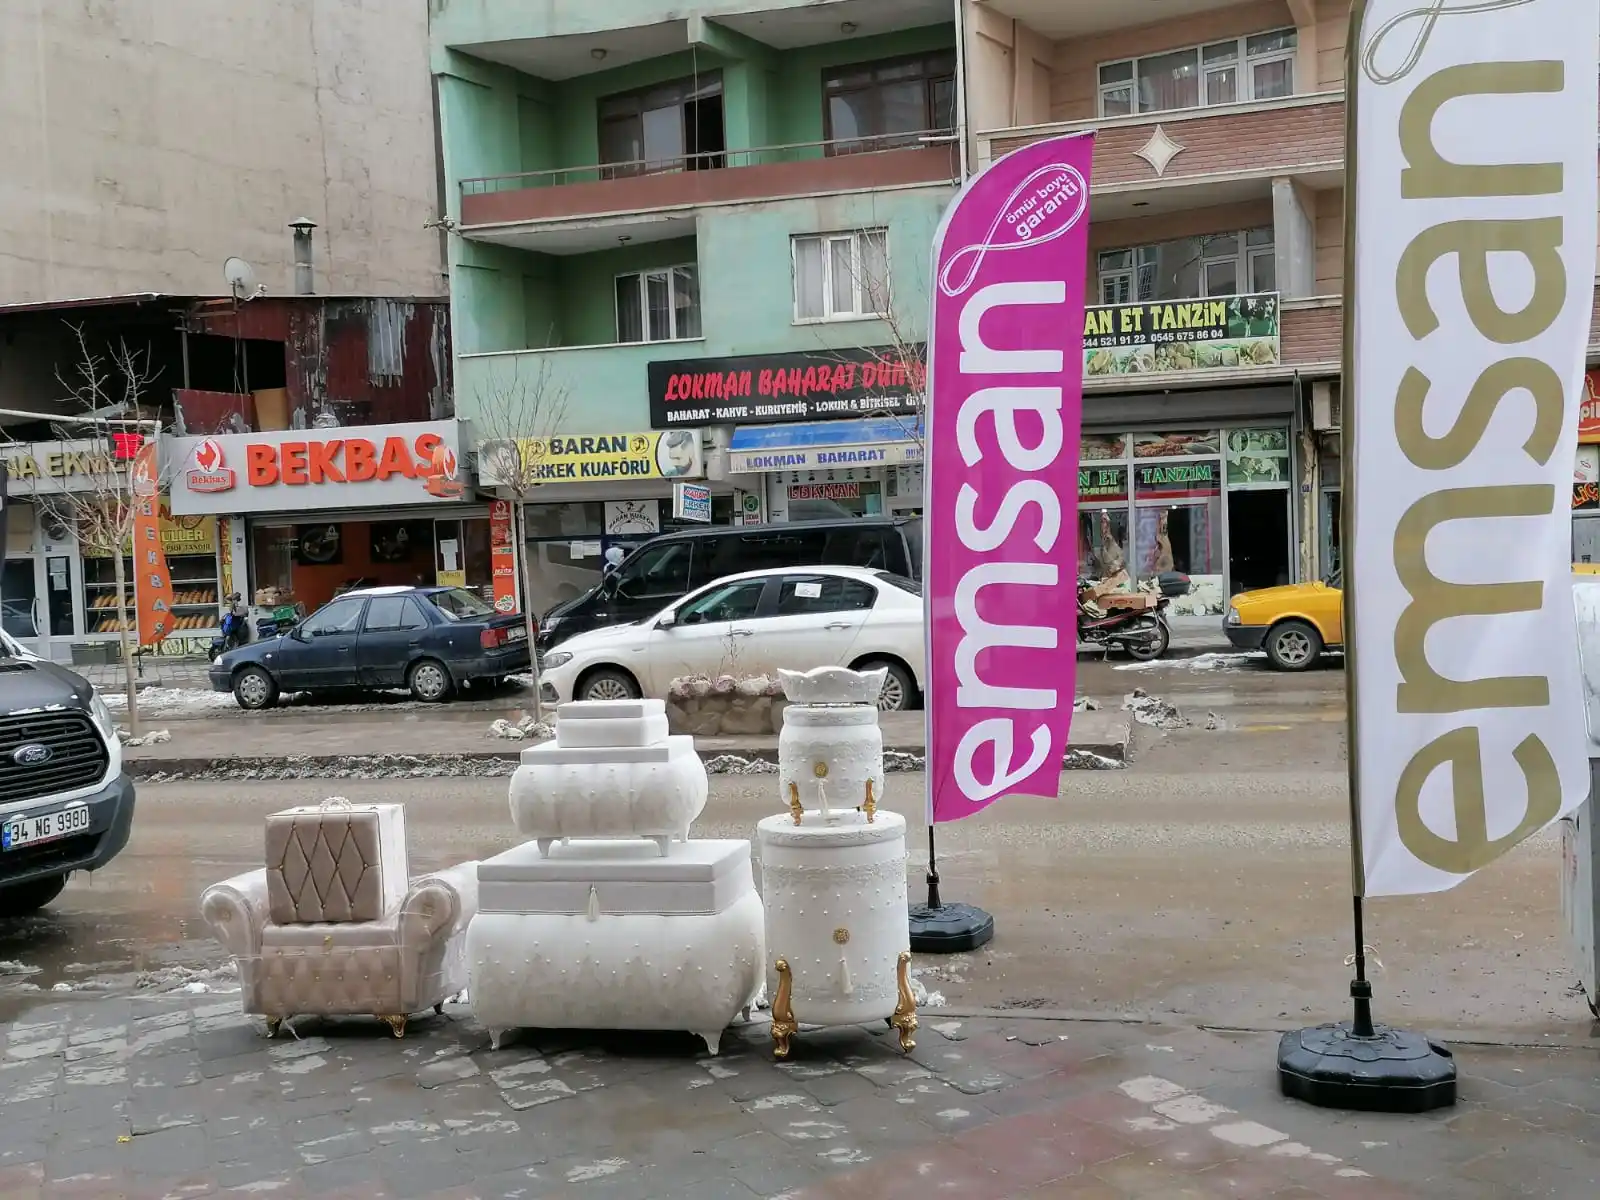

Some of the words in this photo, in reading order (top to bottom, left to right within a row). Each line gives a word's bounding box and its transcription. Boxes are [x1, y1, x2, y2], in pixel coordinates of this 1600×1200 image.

[1006, 195, 1037, 223] ömür
[1036, 173, 1067, 199] boyu
[1016, 179, 1079, 240] garanti
[1120, 307, 1143, 332] ET
[1101, 336, 1117, 347] 521
[1120, 335, 1131, 345] 91
[1134, 334, 1146, 344] 22
[1151, 332, 1174, 343] 0545
[1211, 328, 1223, 339] 04
[664, 369, 752, 401] LOKMAN
[758, 363, 855, 400] BAHARAT
[667, 408, 709, 421] BAHARAT
[816, 398, 849, 412] LOKUM
[550, 436, 627, 456] BARAN
[746, 453, 806, 468] LOKMAN
[818, 449, 886, 464] BAHARAT
[580, 456, 650, 478] KUAFÖRÜ
[1099, 470, 1119, 486] ET
[1393, 59, 1566, 875] emsan
[954, 281, 1066, 802] emsan
[11, 822, 28, 842] 34
[35, 818, 50, 837] NG
[57, 809, 87, 832] 9980
